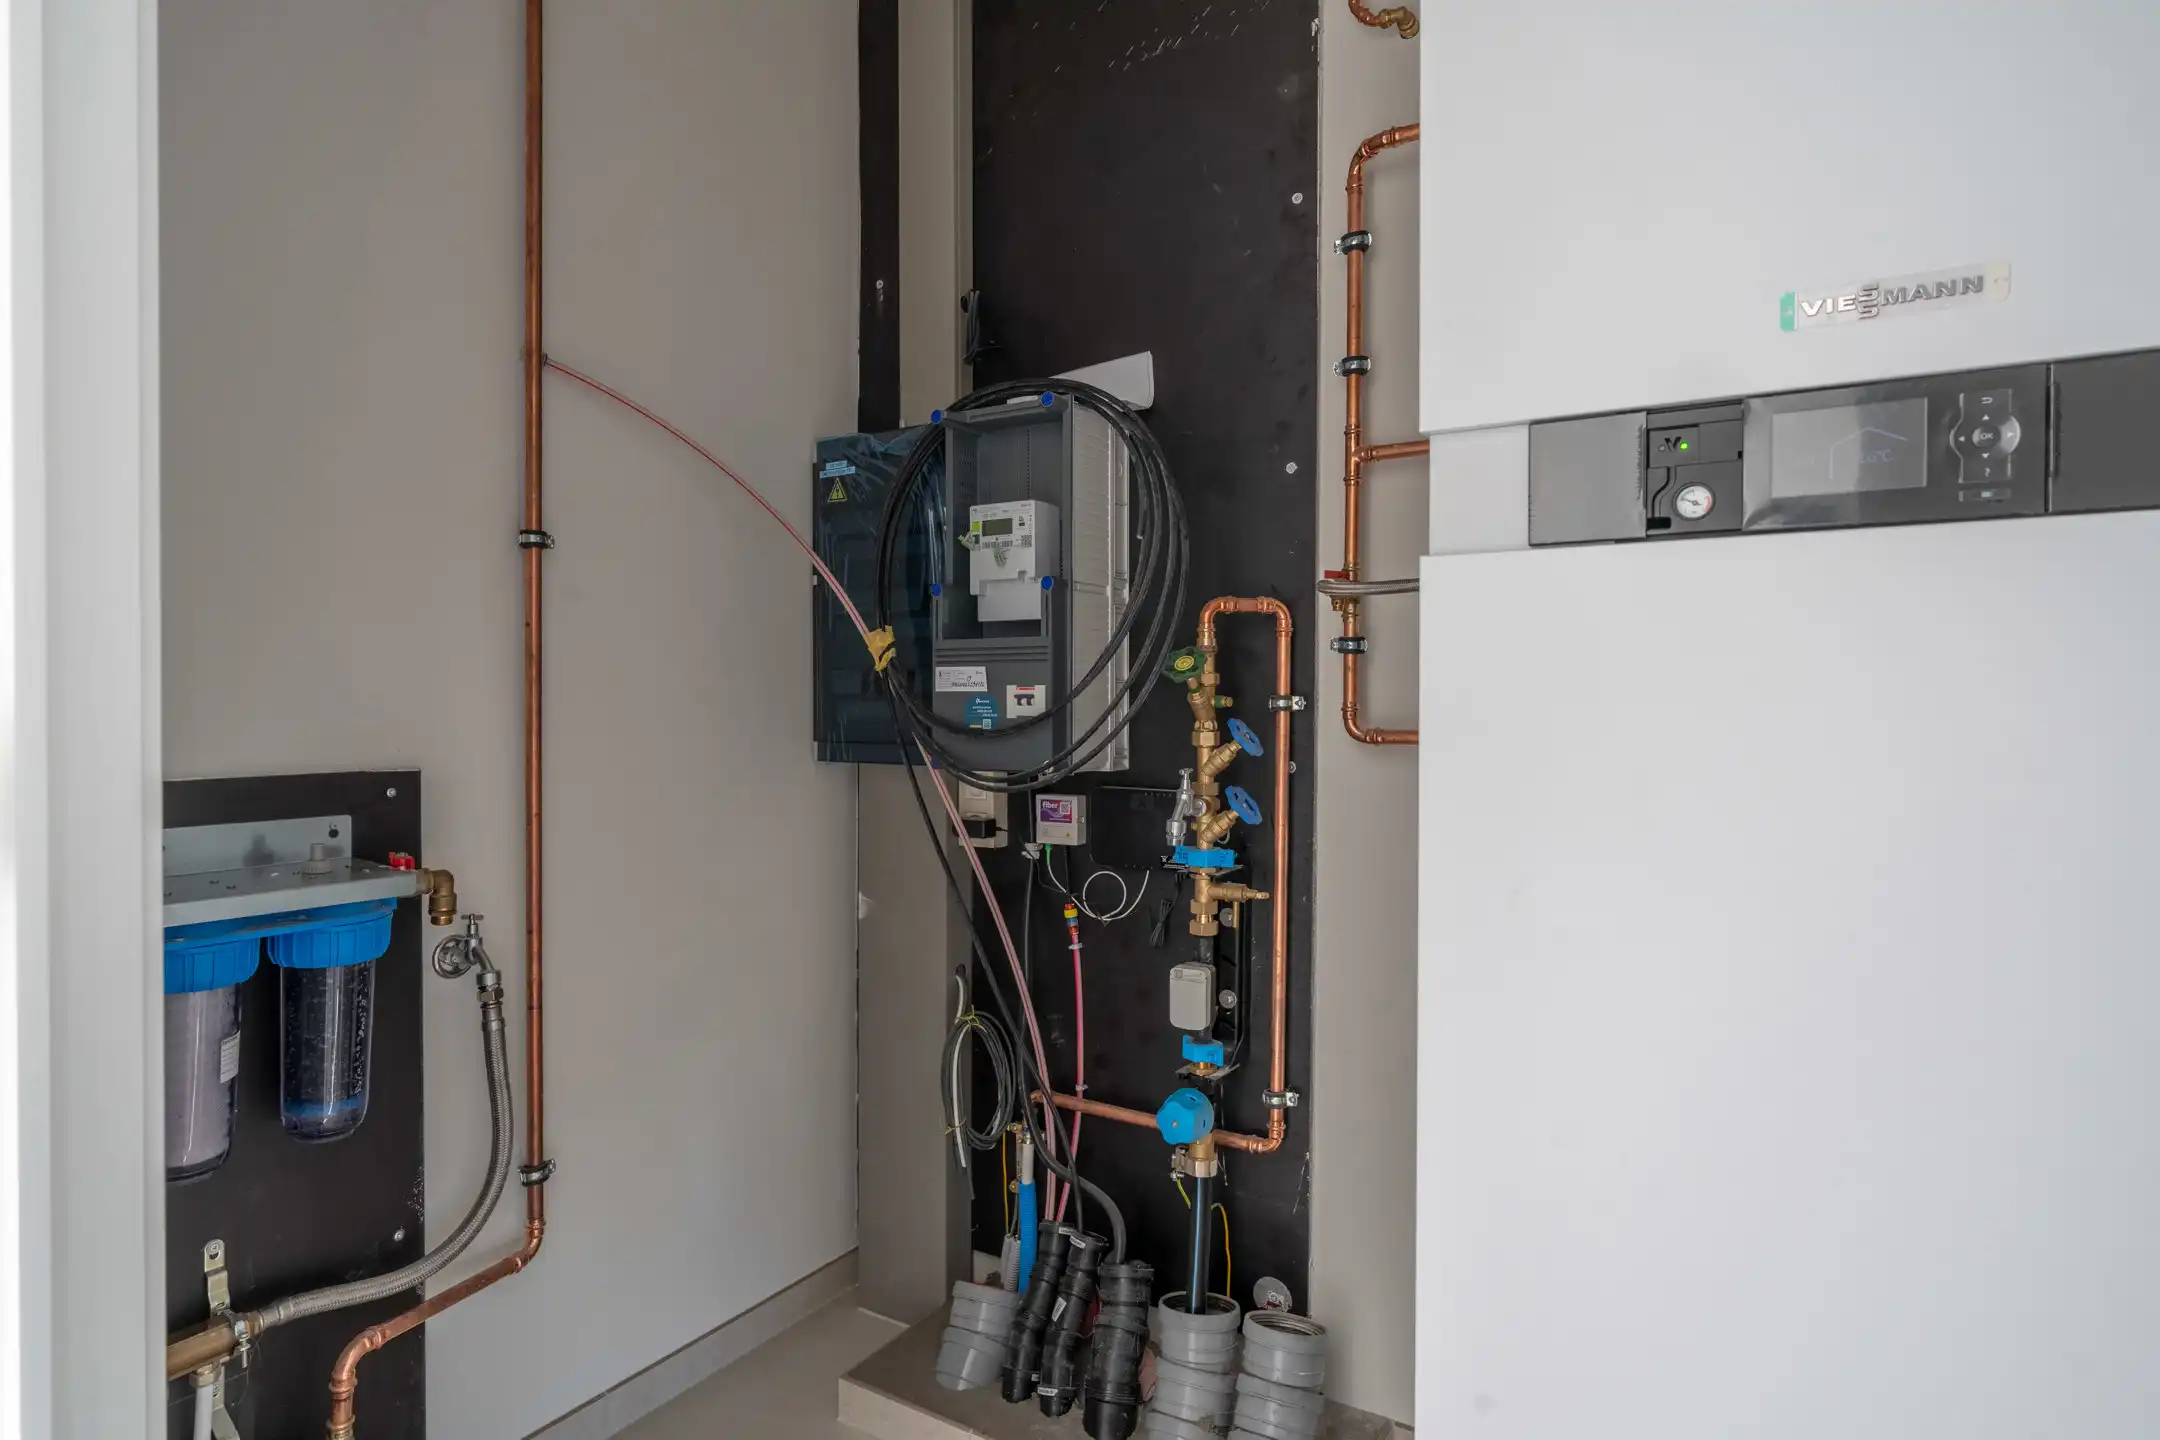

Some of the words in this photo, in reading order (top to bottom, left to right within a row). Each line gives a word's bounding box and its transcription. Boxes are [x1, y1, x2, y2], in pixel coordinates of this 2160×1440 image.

[1800, 274, 1985, 320] VIESSMANN
[1979, 432, 1994, 440] OK
[1042, 800, 1059, 809] fiber
